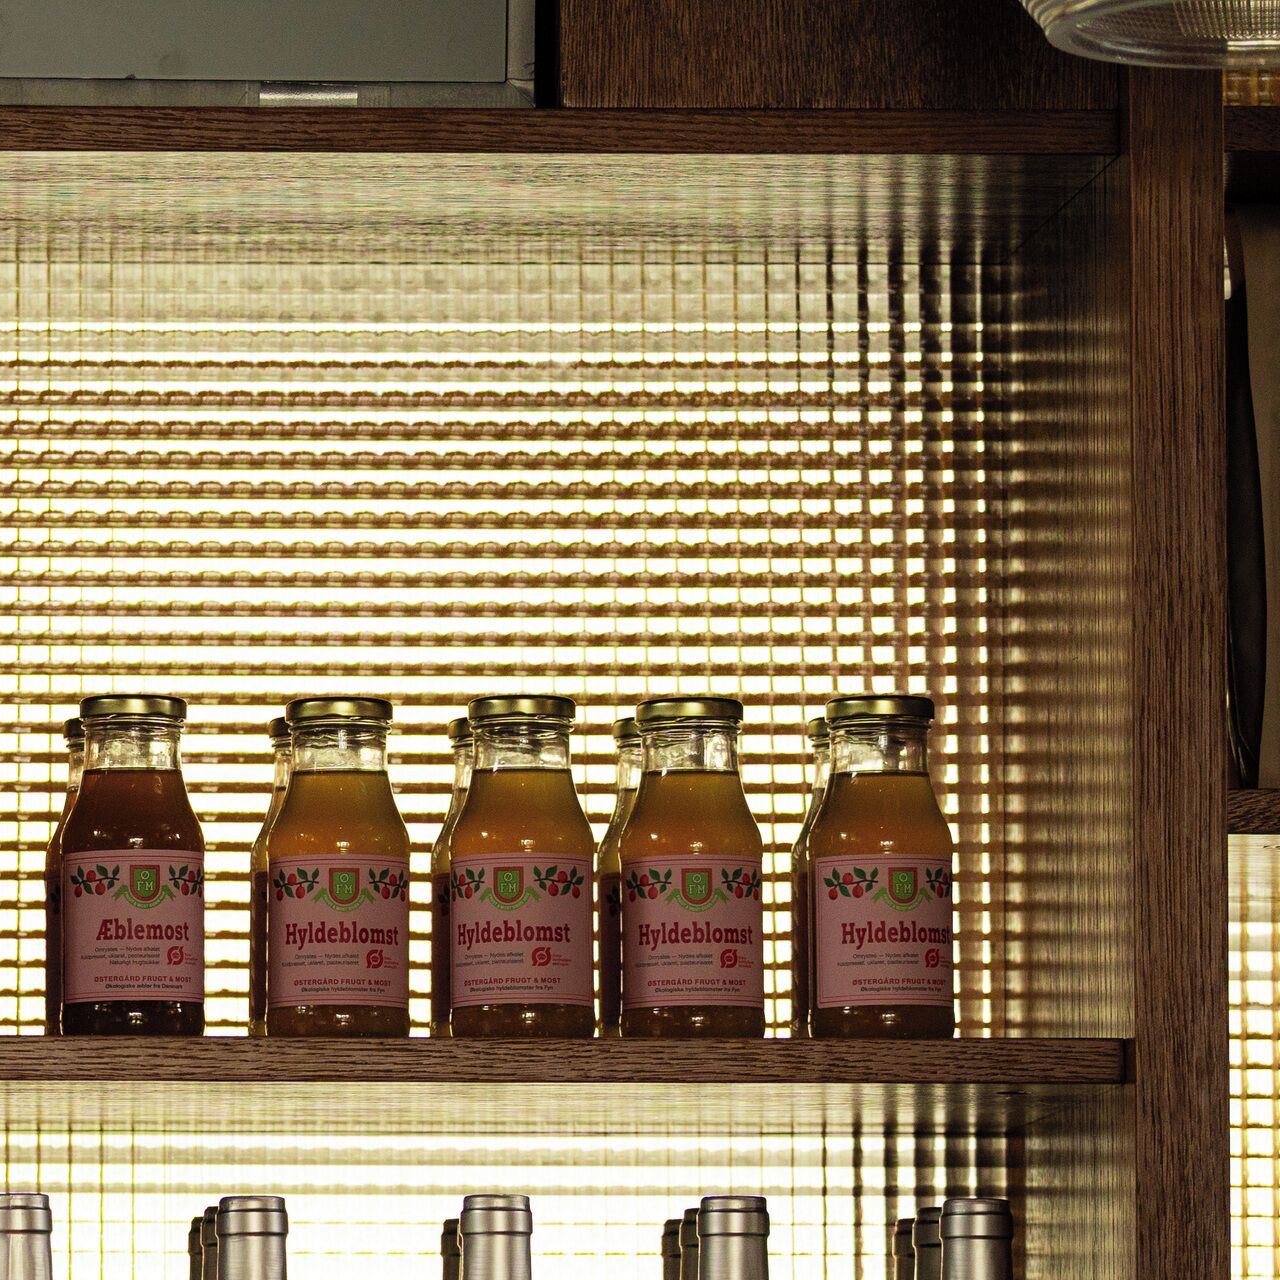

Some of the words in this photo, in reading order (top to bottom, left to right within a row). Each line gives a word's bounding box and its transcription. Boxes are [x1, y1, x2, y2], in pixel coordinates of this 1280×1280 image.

[96, 918, 190, 941] Æblemost
[285, 921, 399, 950] Hyldeblomst
[458, 920, 570, 951] Hyldeblomst
[638, 921, 753, 951] Hyldeblomst
[841, 920, 950, 950] Hyldeblomst
[94, 974, 140, 983] ØSTERGÅRD
[175, 976, 192, 984] MOST
[294, 978, 339, 986] ØSTERGÅRD
[647, 978, 693, 987] ØSTERGÅRD
